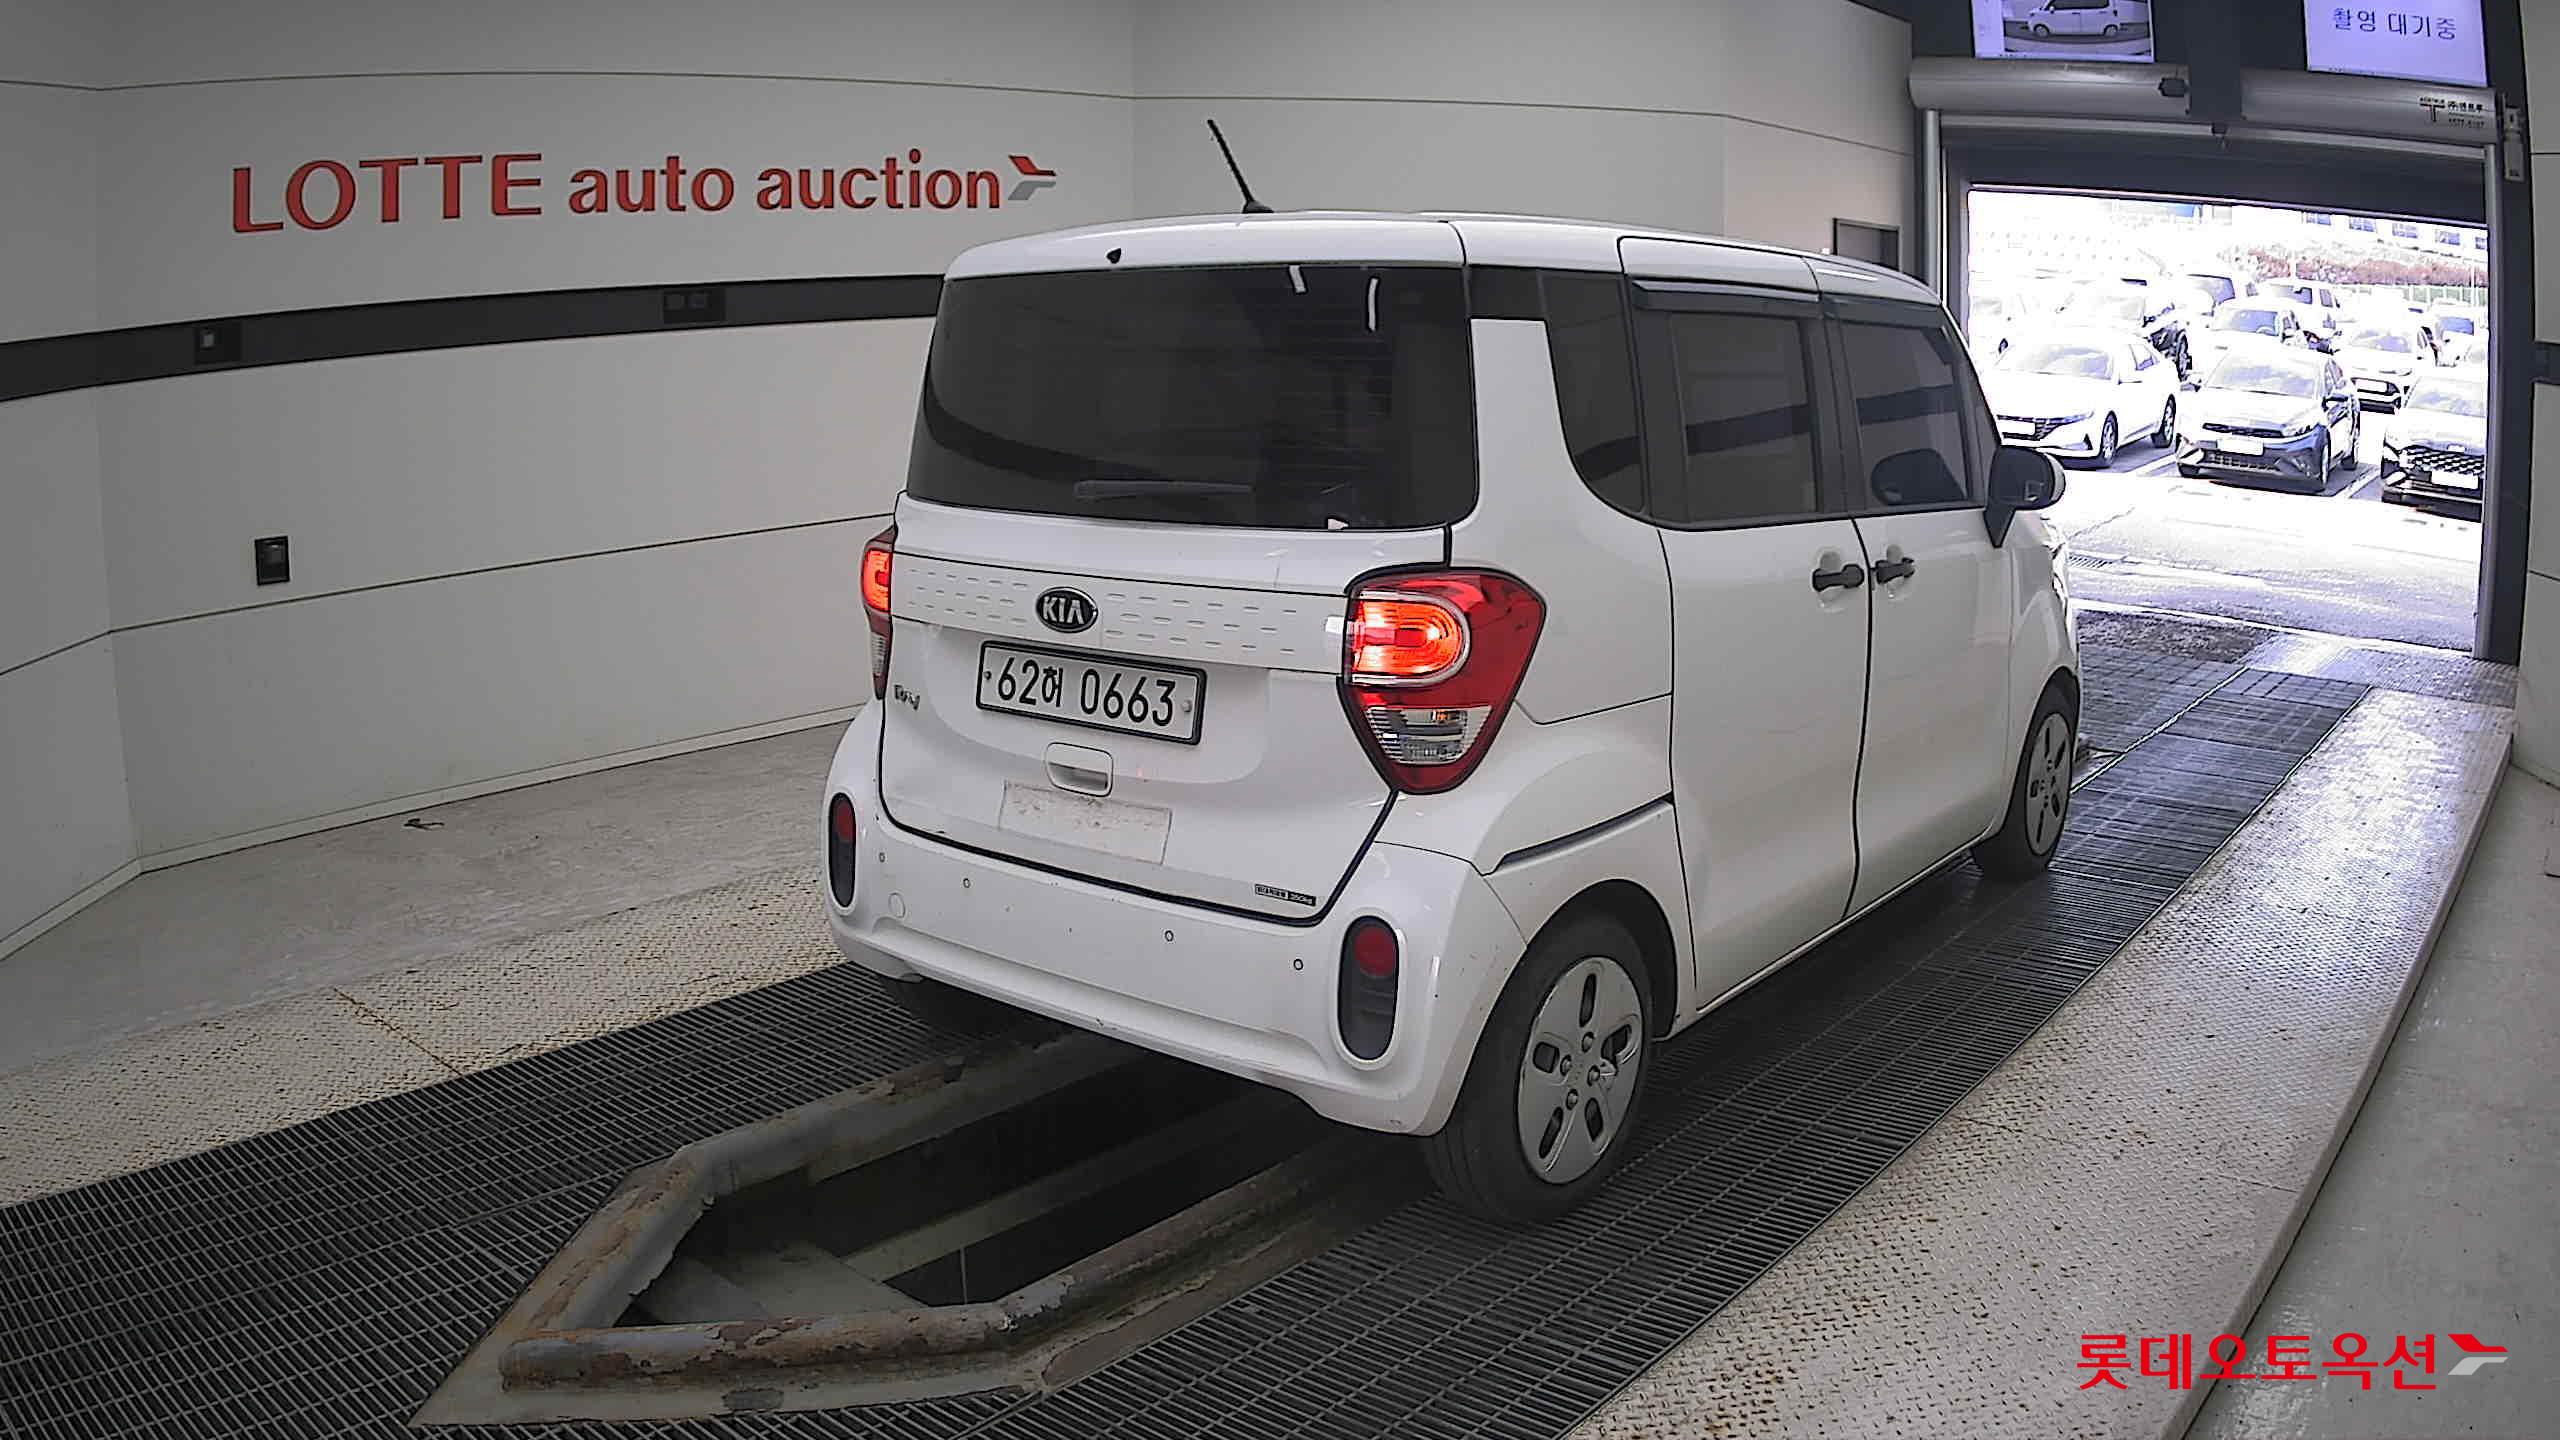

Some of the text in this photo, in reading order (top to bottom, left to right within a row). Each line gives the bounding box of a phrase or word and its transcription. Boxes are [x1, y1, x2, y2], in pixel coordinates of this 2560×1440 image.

[2333, 7, 2377, 33] 촬영
[232, 149, 1001, 233] LOTTE auto auction
[1042, 596, 1085, 624] KIA
[997, 656, 1176, 727] 62허 0663
